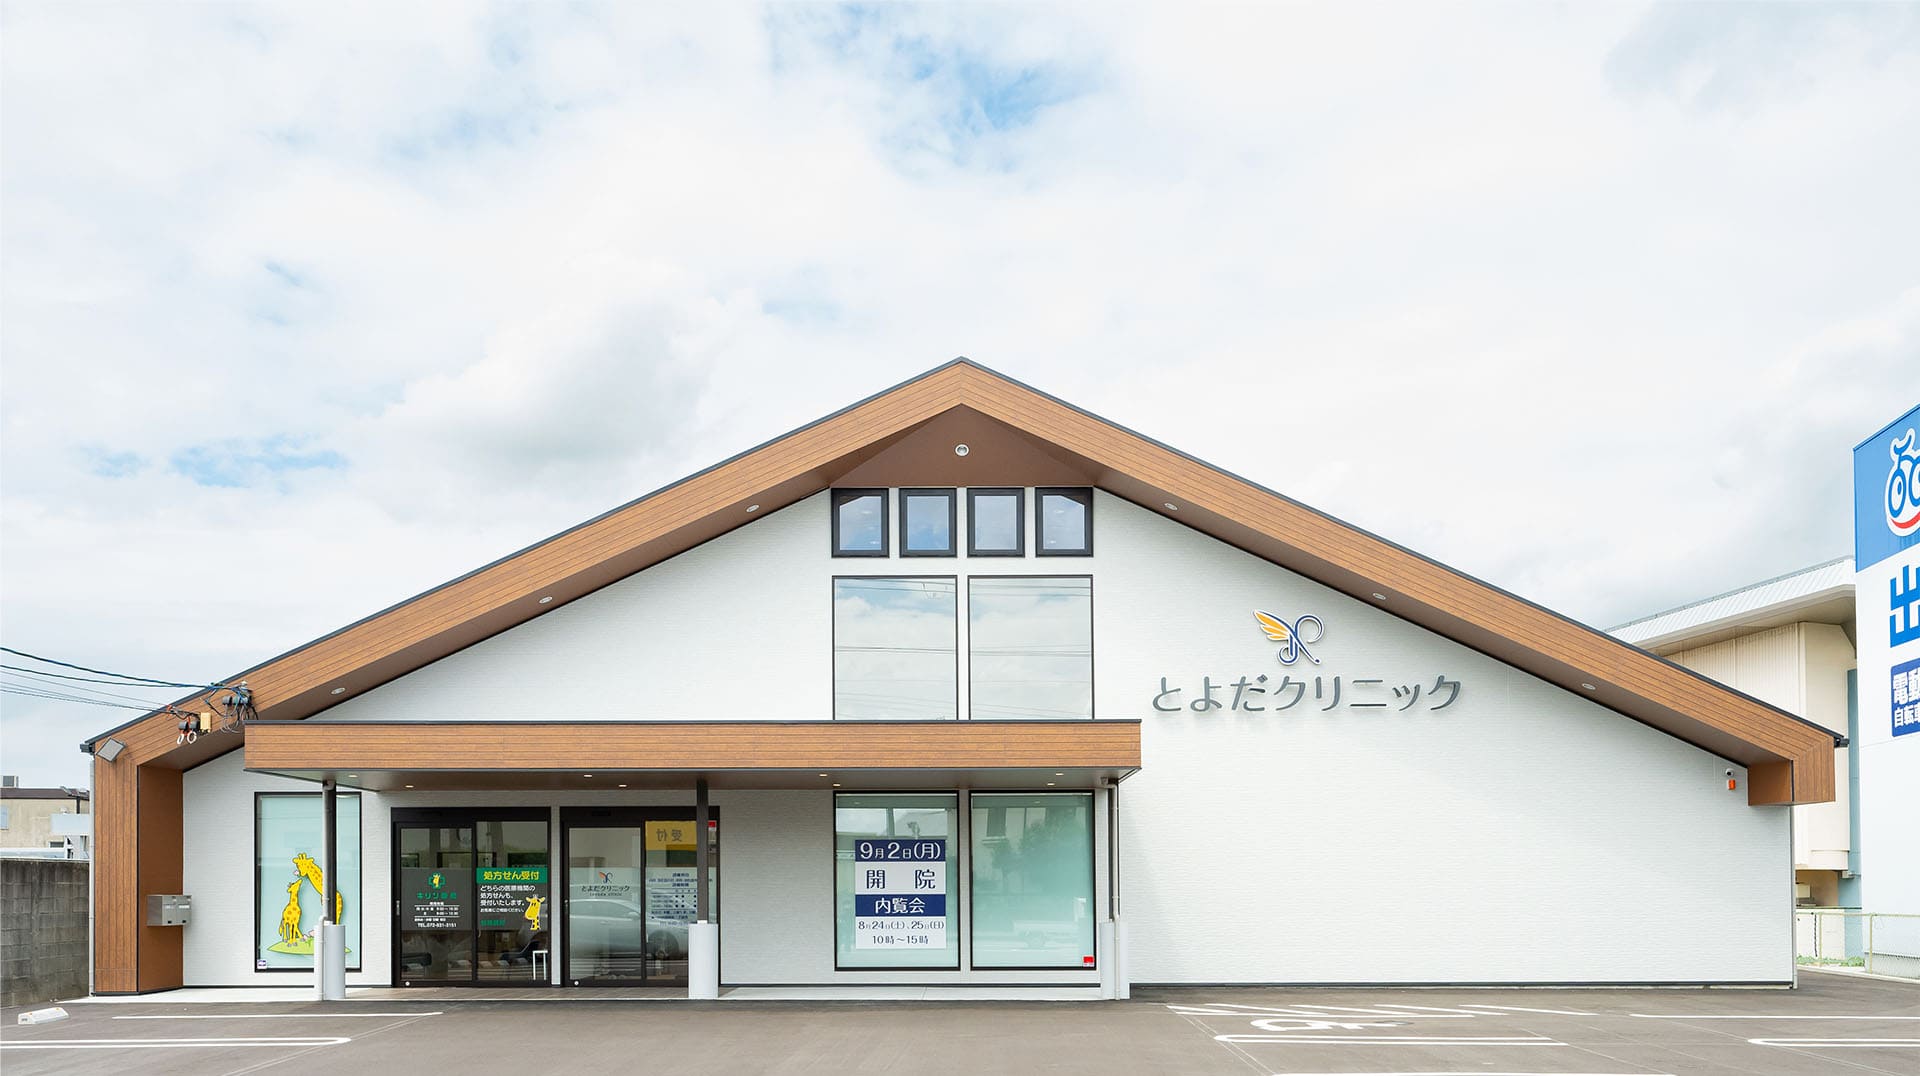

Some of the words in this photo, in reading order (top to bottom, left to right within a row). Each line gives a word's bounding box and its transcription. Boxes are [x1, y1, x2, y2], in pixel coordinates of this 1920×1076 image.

[1152, 675, 1461, 711] とよだクリニック
[860, 842, 941, 859] 9月2日(月)
[484, 871, 539, 881] 処方せん受付
[875, 897, 926, 914] 内覧会
